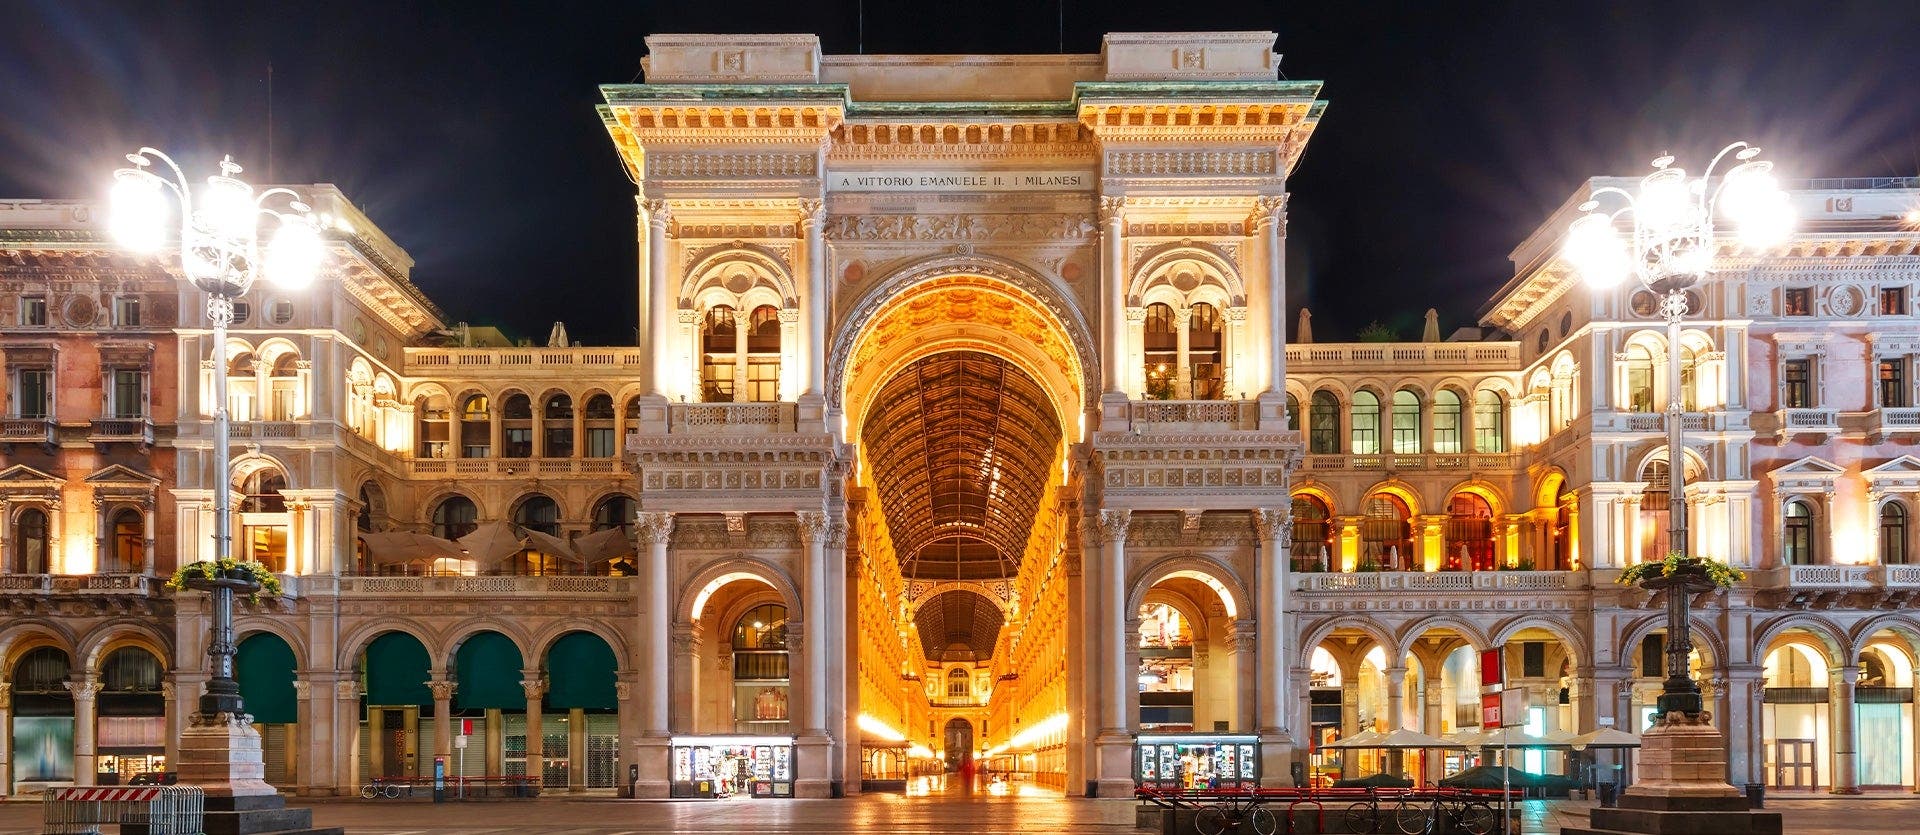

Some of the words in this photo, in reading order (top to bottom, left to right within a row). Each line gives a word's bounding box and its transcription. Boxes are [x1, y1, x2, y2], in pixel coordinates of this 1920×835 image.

[842, 178, 850, 186] A
[858, 176, 914, 186] VITTORIO
[920, 176, 987, 186] EMANUELE
[1025, 175, 1081, 186] MILANESI
